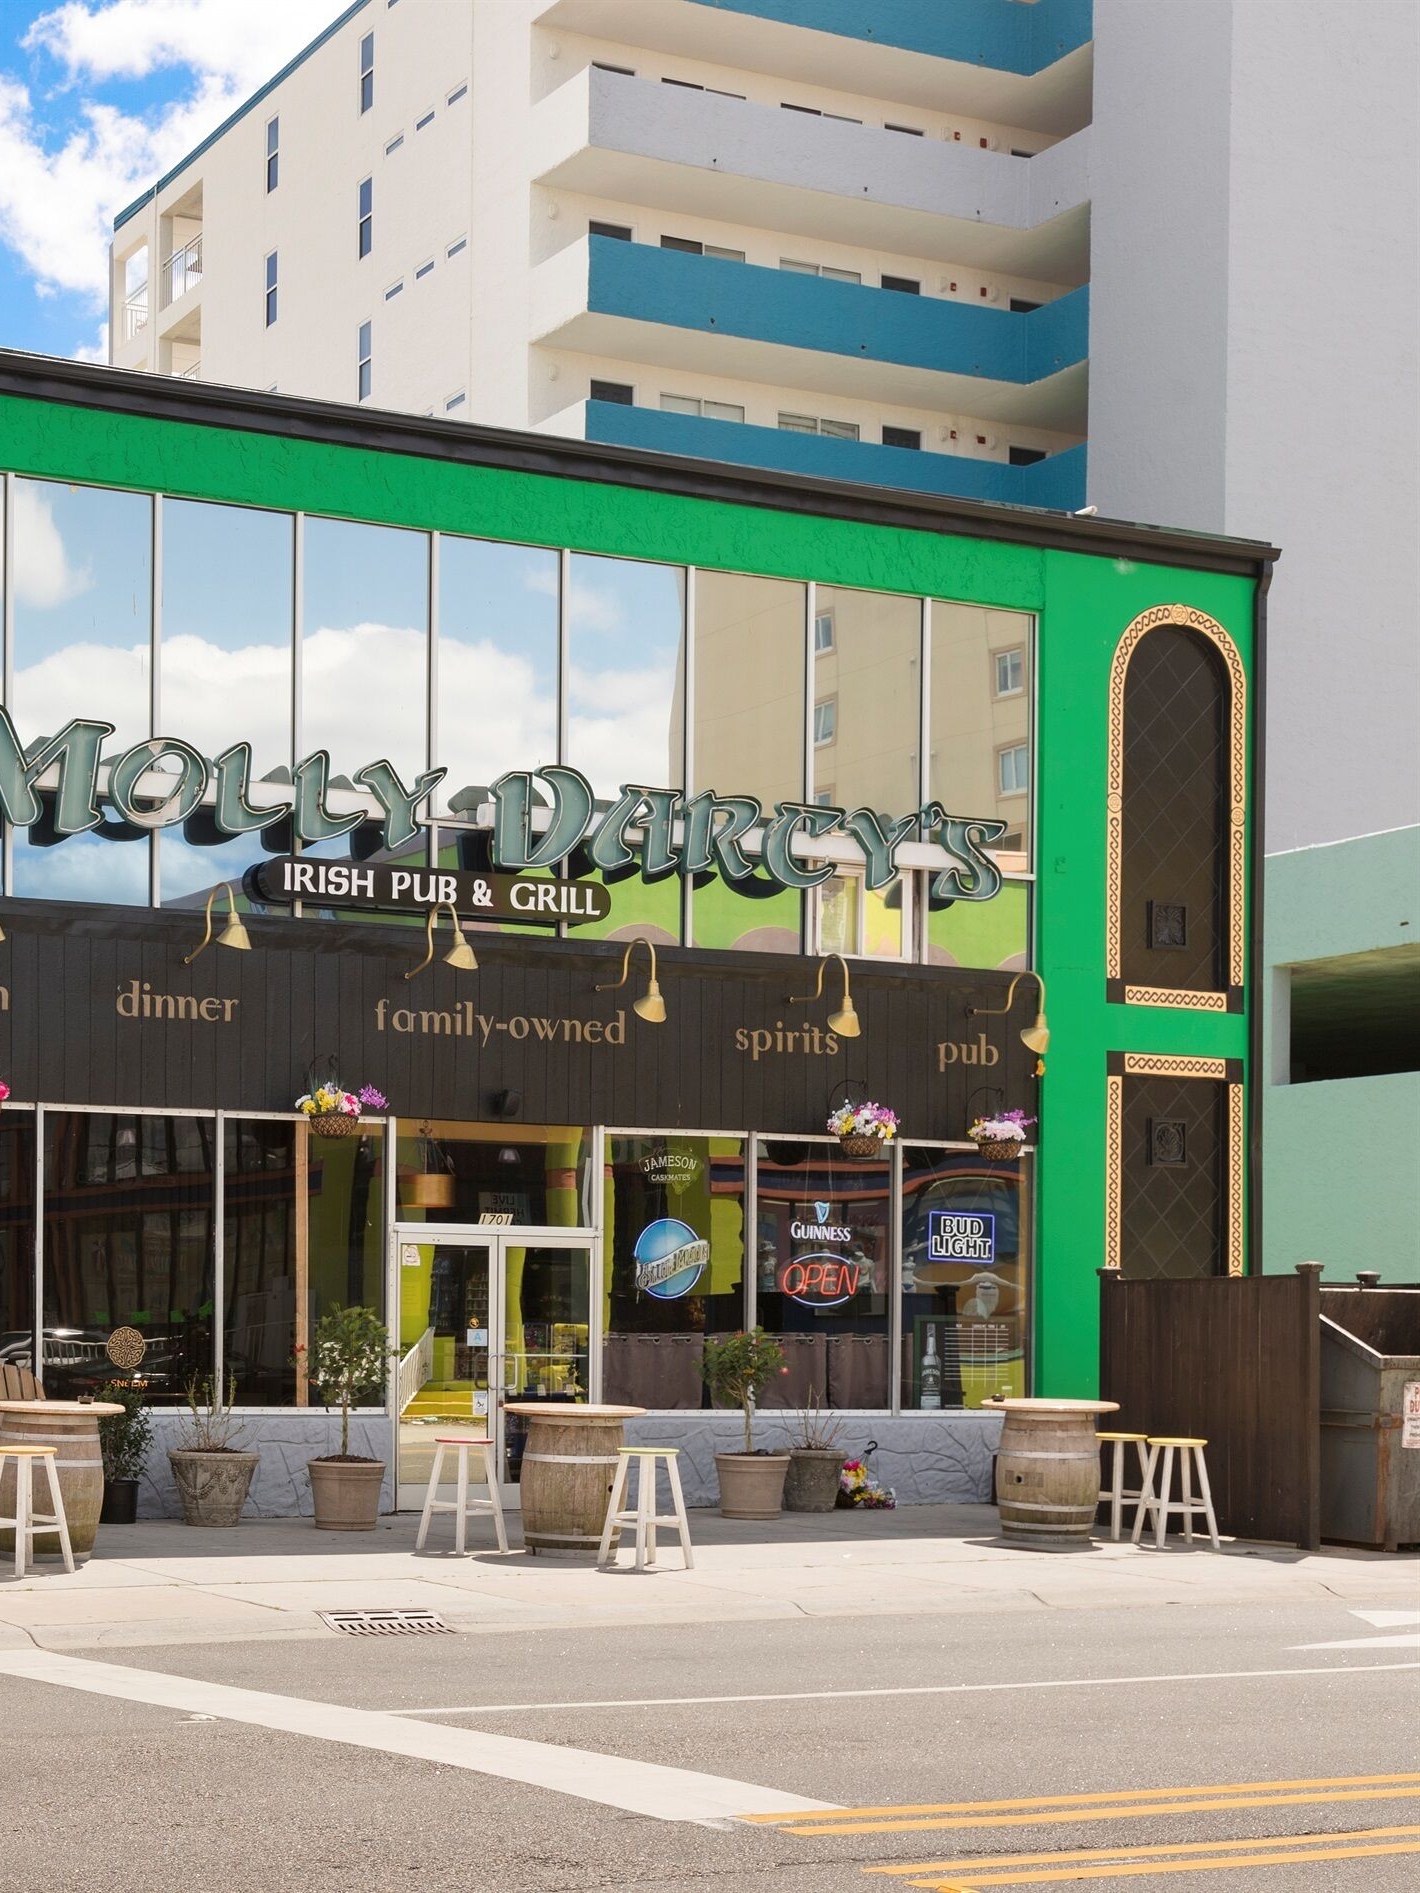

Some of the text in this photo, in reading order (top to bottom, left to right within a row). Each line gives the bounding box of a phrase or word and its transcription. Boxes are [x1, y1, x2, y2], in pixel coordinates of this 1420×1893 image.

[488, 765, 1008, 901] DARCY'S
[283, 862, 601, 916] IRISH PUB & GRILL
[116, 979, 240, 1023] dinner
[374, 998, 626, 1048] family-owned
[735, 1020, 839, 1061] spirits
[937, 1033, 999, 1073] pub
[644, 1155, 697, 1172] JAMESON
[651, 1174, 691, 1182] CASKMATES
[481, 1214, 510, 1225] 1701
[790, 1221, 851, 1242] GUINNESS
[941, 1215, 984, 1238] BUD
[932, 1235, 992, 1258] LIGHT
[783, 1264, 859, 1295] OPEN
